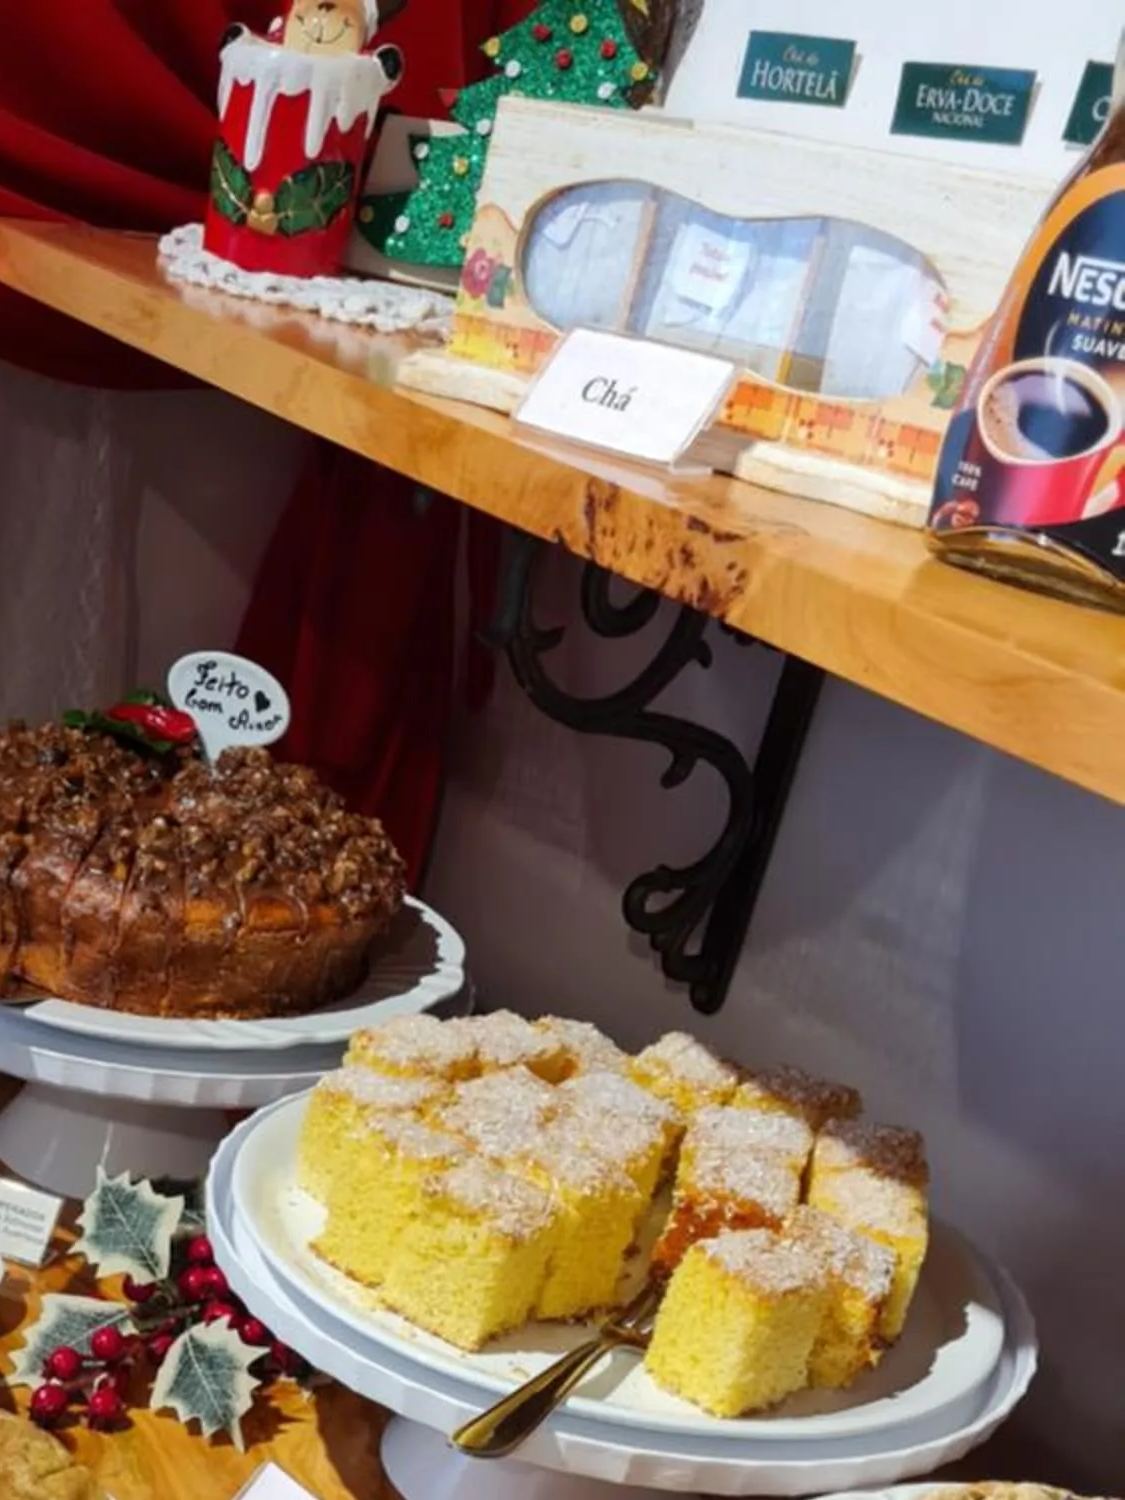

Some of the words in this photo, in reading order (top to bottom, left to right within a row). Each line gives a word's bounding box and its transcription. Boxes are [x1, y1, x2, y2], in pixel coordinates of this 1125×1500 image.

[750, 59, 840, 100] HORTELÃ
[1070, 333, 1125, 360] SUAVE
[581, 376, 638, 413] Chá
[194, 660, 250, 699] Feito
